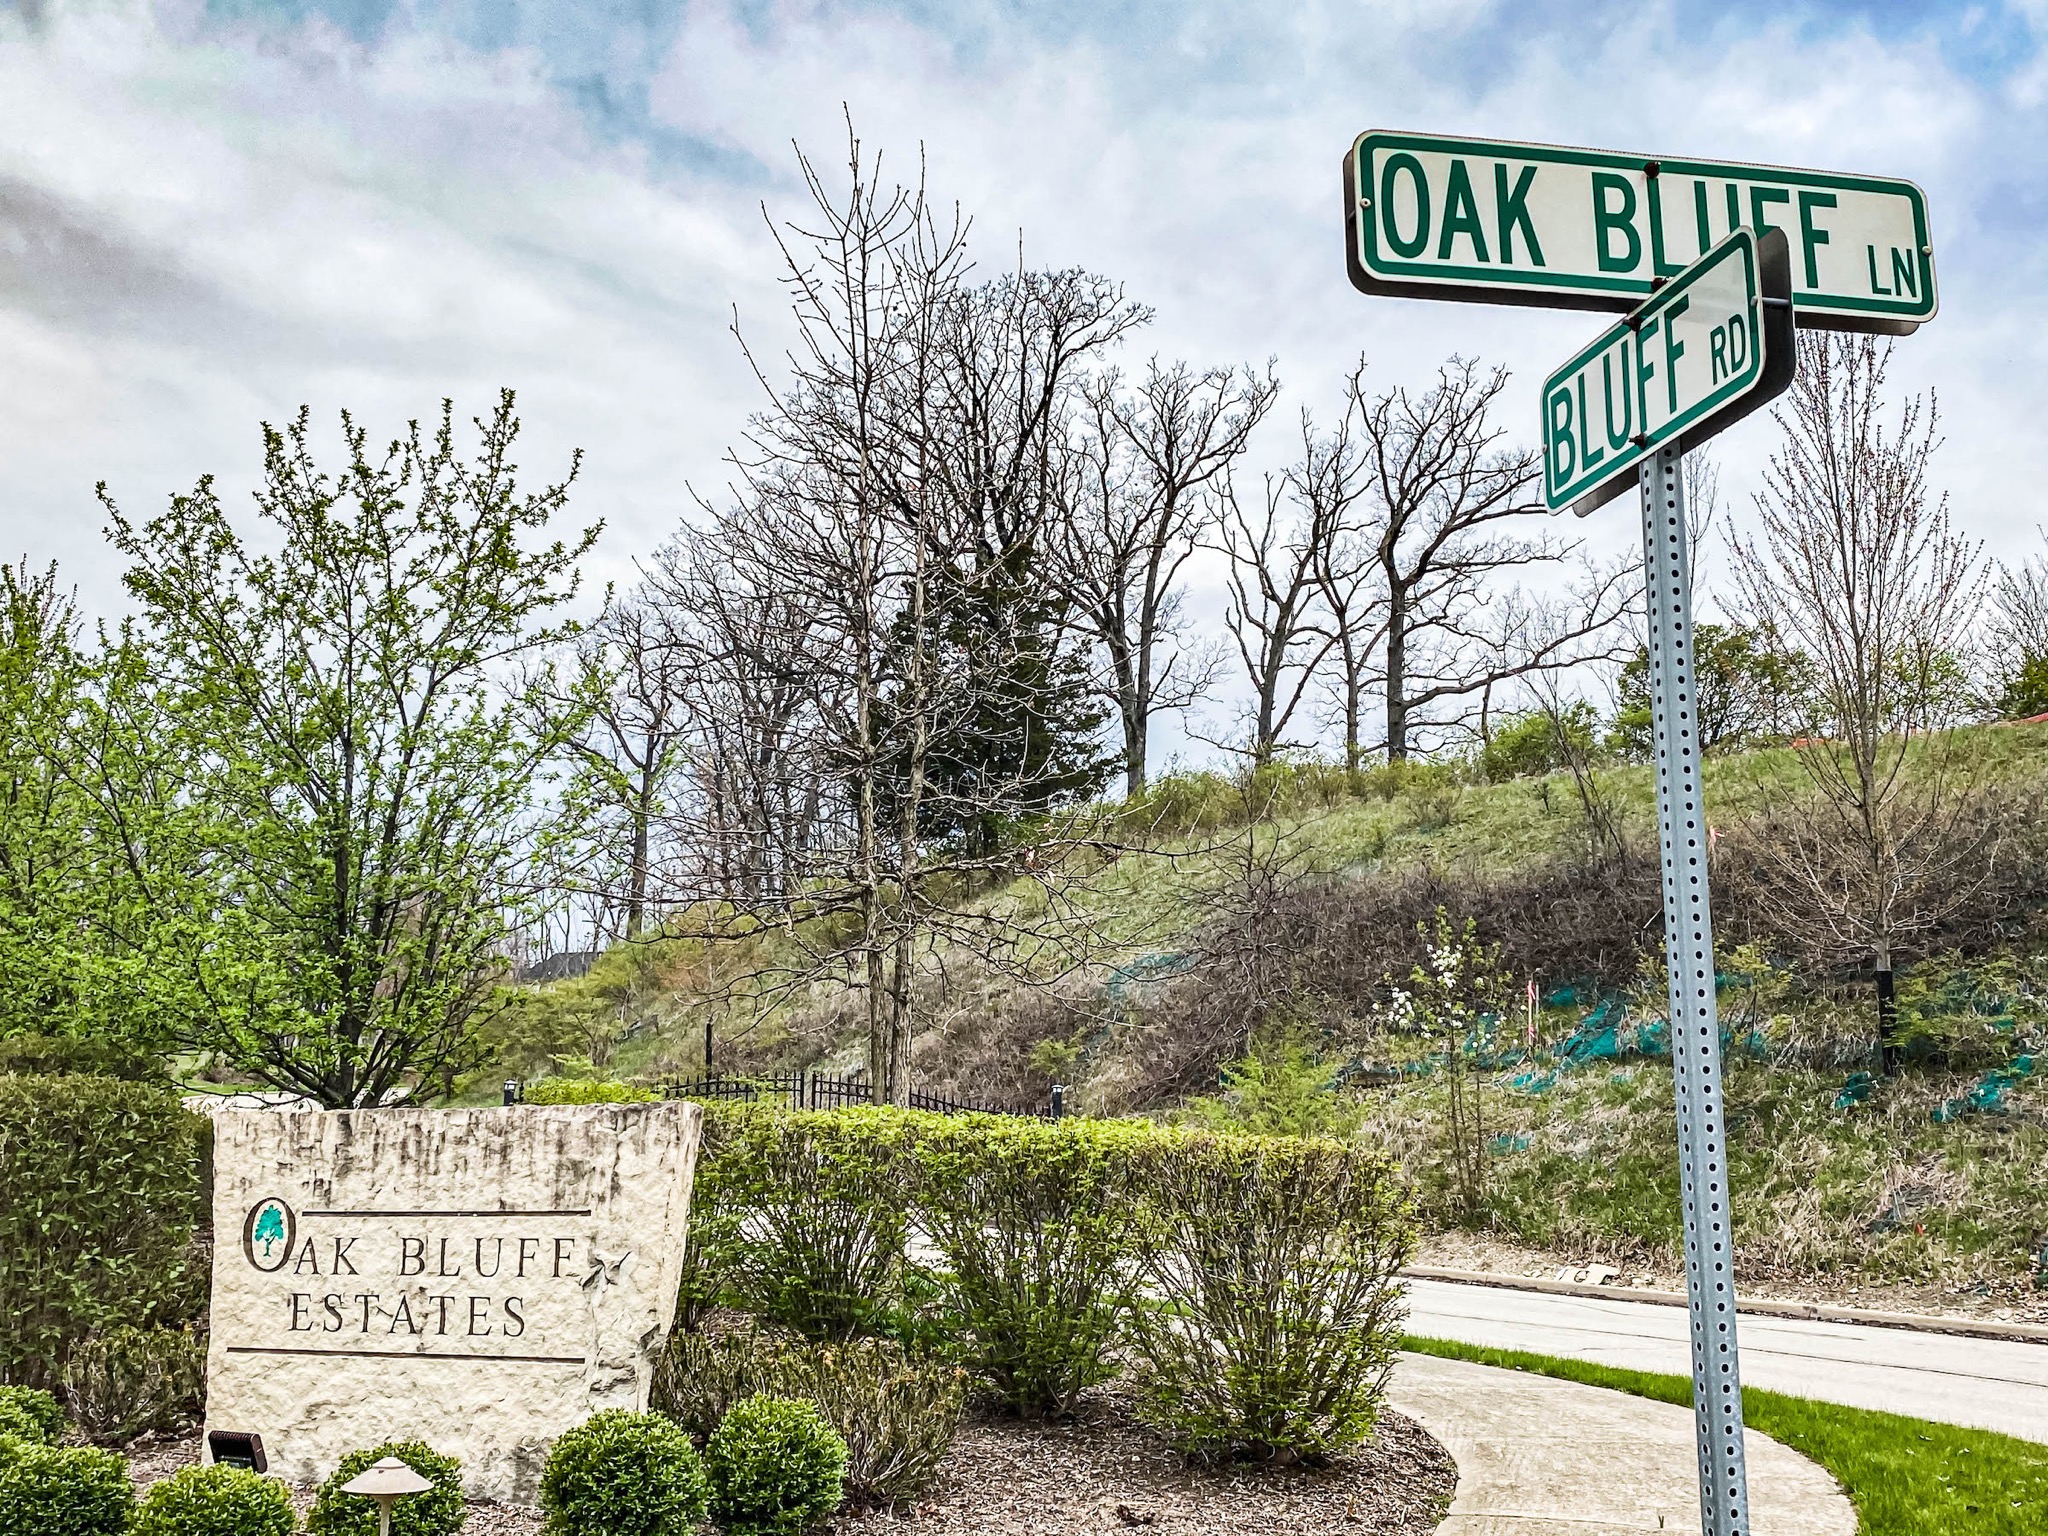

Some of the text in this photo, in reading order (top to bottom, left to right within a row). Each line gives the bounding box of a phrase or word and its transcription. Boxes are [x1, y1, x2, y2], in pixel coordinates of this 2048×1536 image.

[1381, 152, 1546, 267] OAK
[1867, 245, 1917, 298] LN
[1551, 294, 1746, 491] BLUFF RD
[243, 1197, 576, 1277] OAK BLUFF
[289, 1293, 526, 1337] ESTATES
